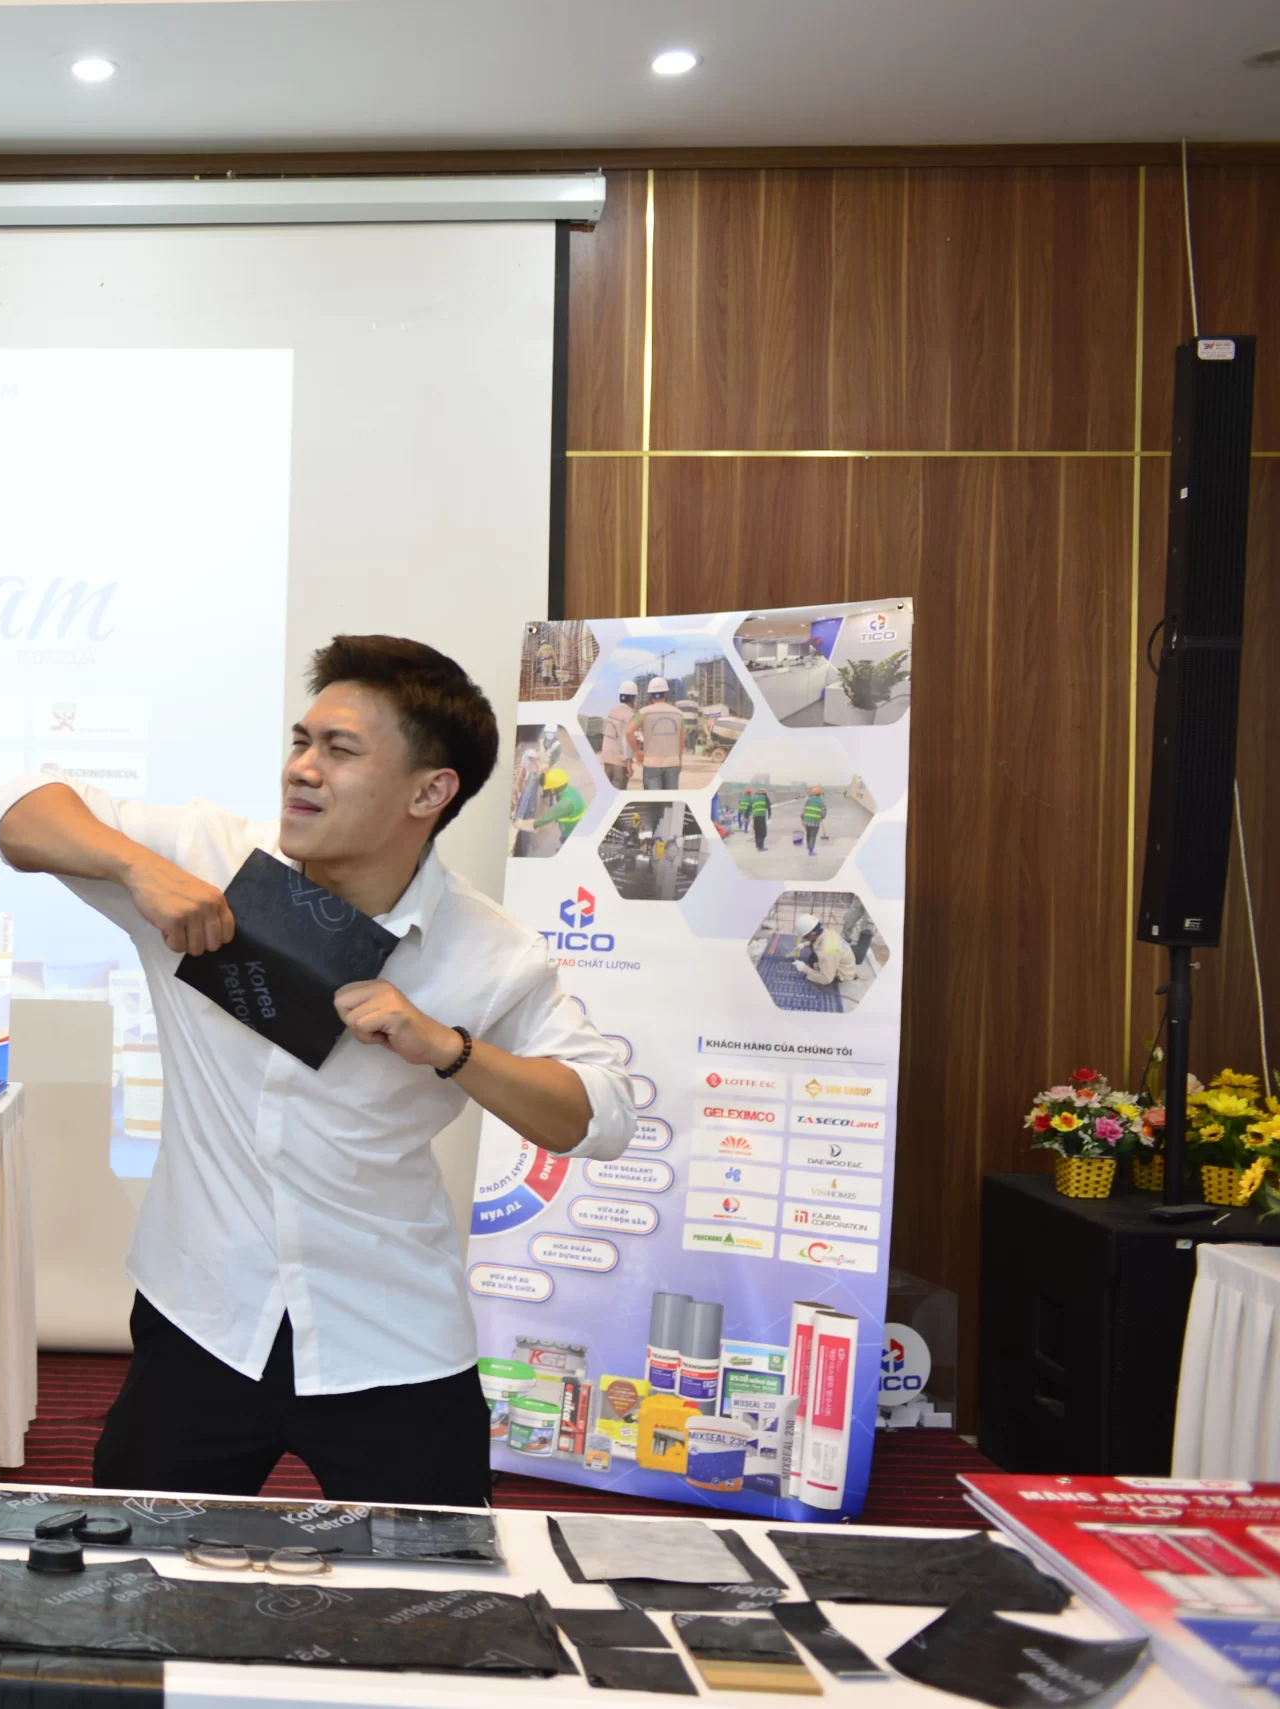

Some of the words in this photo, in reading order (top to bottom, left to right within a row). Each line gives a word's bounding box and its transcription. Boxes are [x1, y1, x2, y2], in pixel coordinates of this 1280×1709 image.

[860, 631, 896, 642] TICO
[244, 960, 276, 1019] Korea
[706, 1038, 742, 1050] KHÁCH
[743, 1040, 773, 1052] HÀNG
[774, 1042, 796, 1054] CỦA
[797, 1044, 834, 1055] CHÚNG
[835, 1046, 853, 1057] TÔI
[725, 1078, 758, 1088] LOTTE
[703, 1106, 776, 1123] GELEXIMCO
[807, 1157, 847, 1168] DAEWOO
[811, 1219, 868, 1232] CORPORATION
[878, 1375, 922, 1391] ICO
[688, 1431, 727, 1446] MIXSEAL
[729, 1436, 749, 1447] 230
[784, 1420, 795, 1443] 230
[782, 1445, 794, 1481] MIXSEAL
